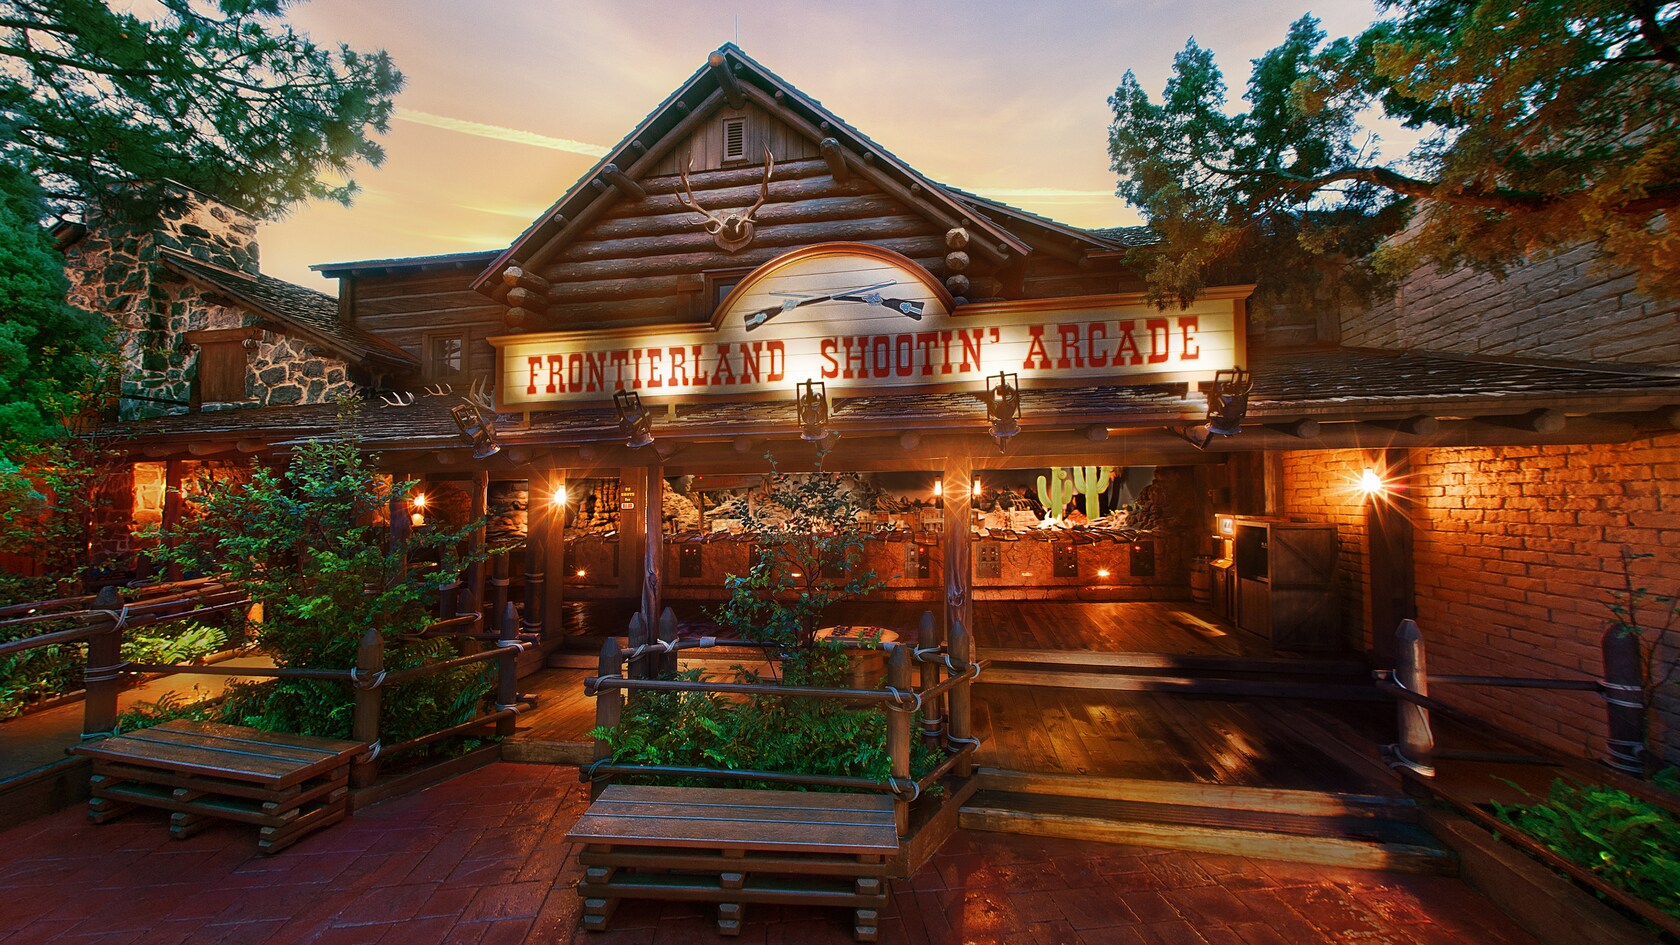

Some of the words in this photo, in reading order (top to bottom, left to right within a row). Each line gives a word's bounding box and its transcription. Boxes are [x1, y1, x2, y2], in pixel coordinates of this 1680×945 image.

[527, 339, 785, 395] FRONTIERLAND
[820, 325, 1000, 379] SHOOTIN'
[1023, 314, 1201, 370] ARCADE
